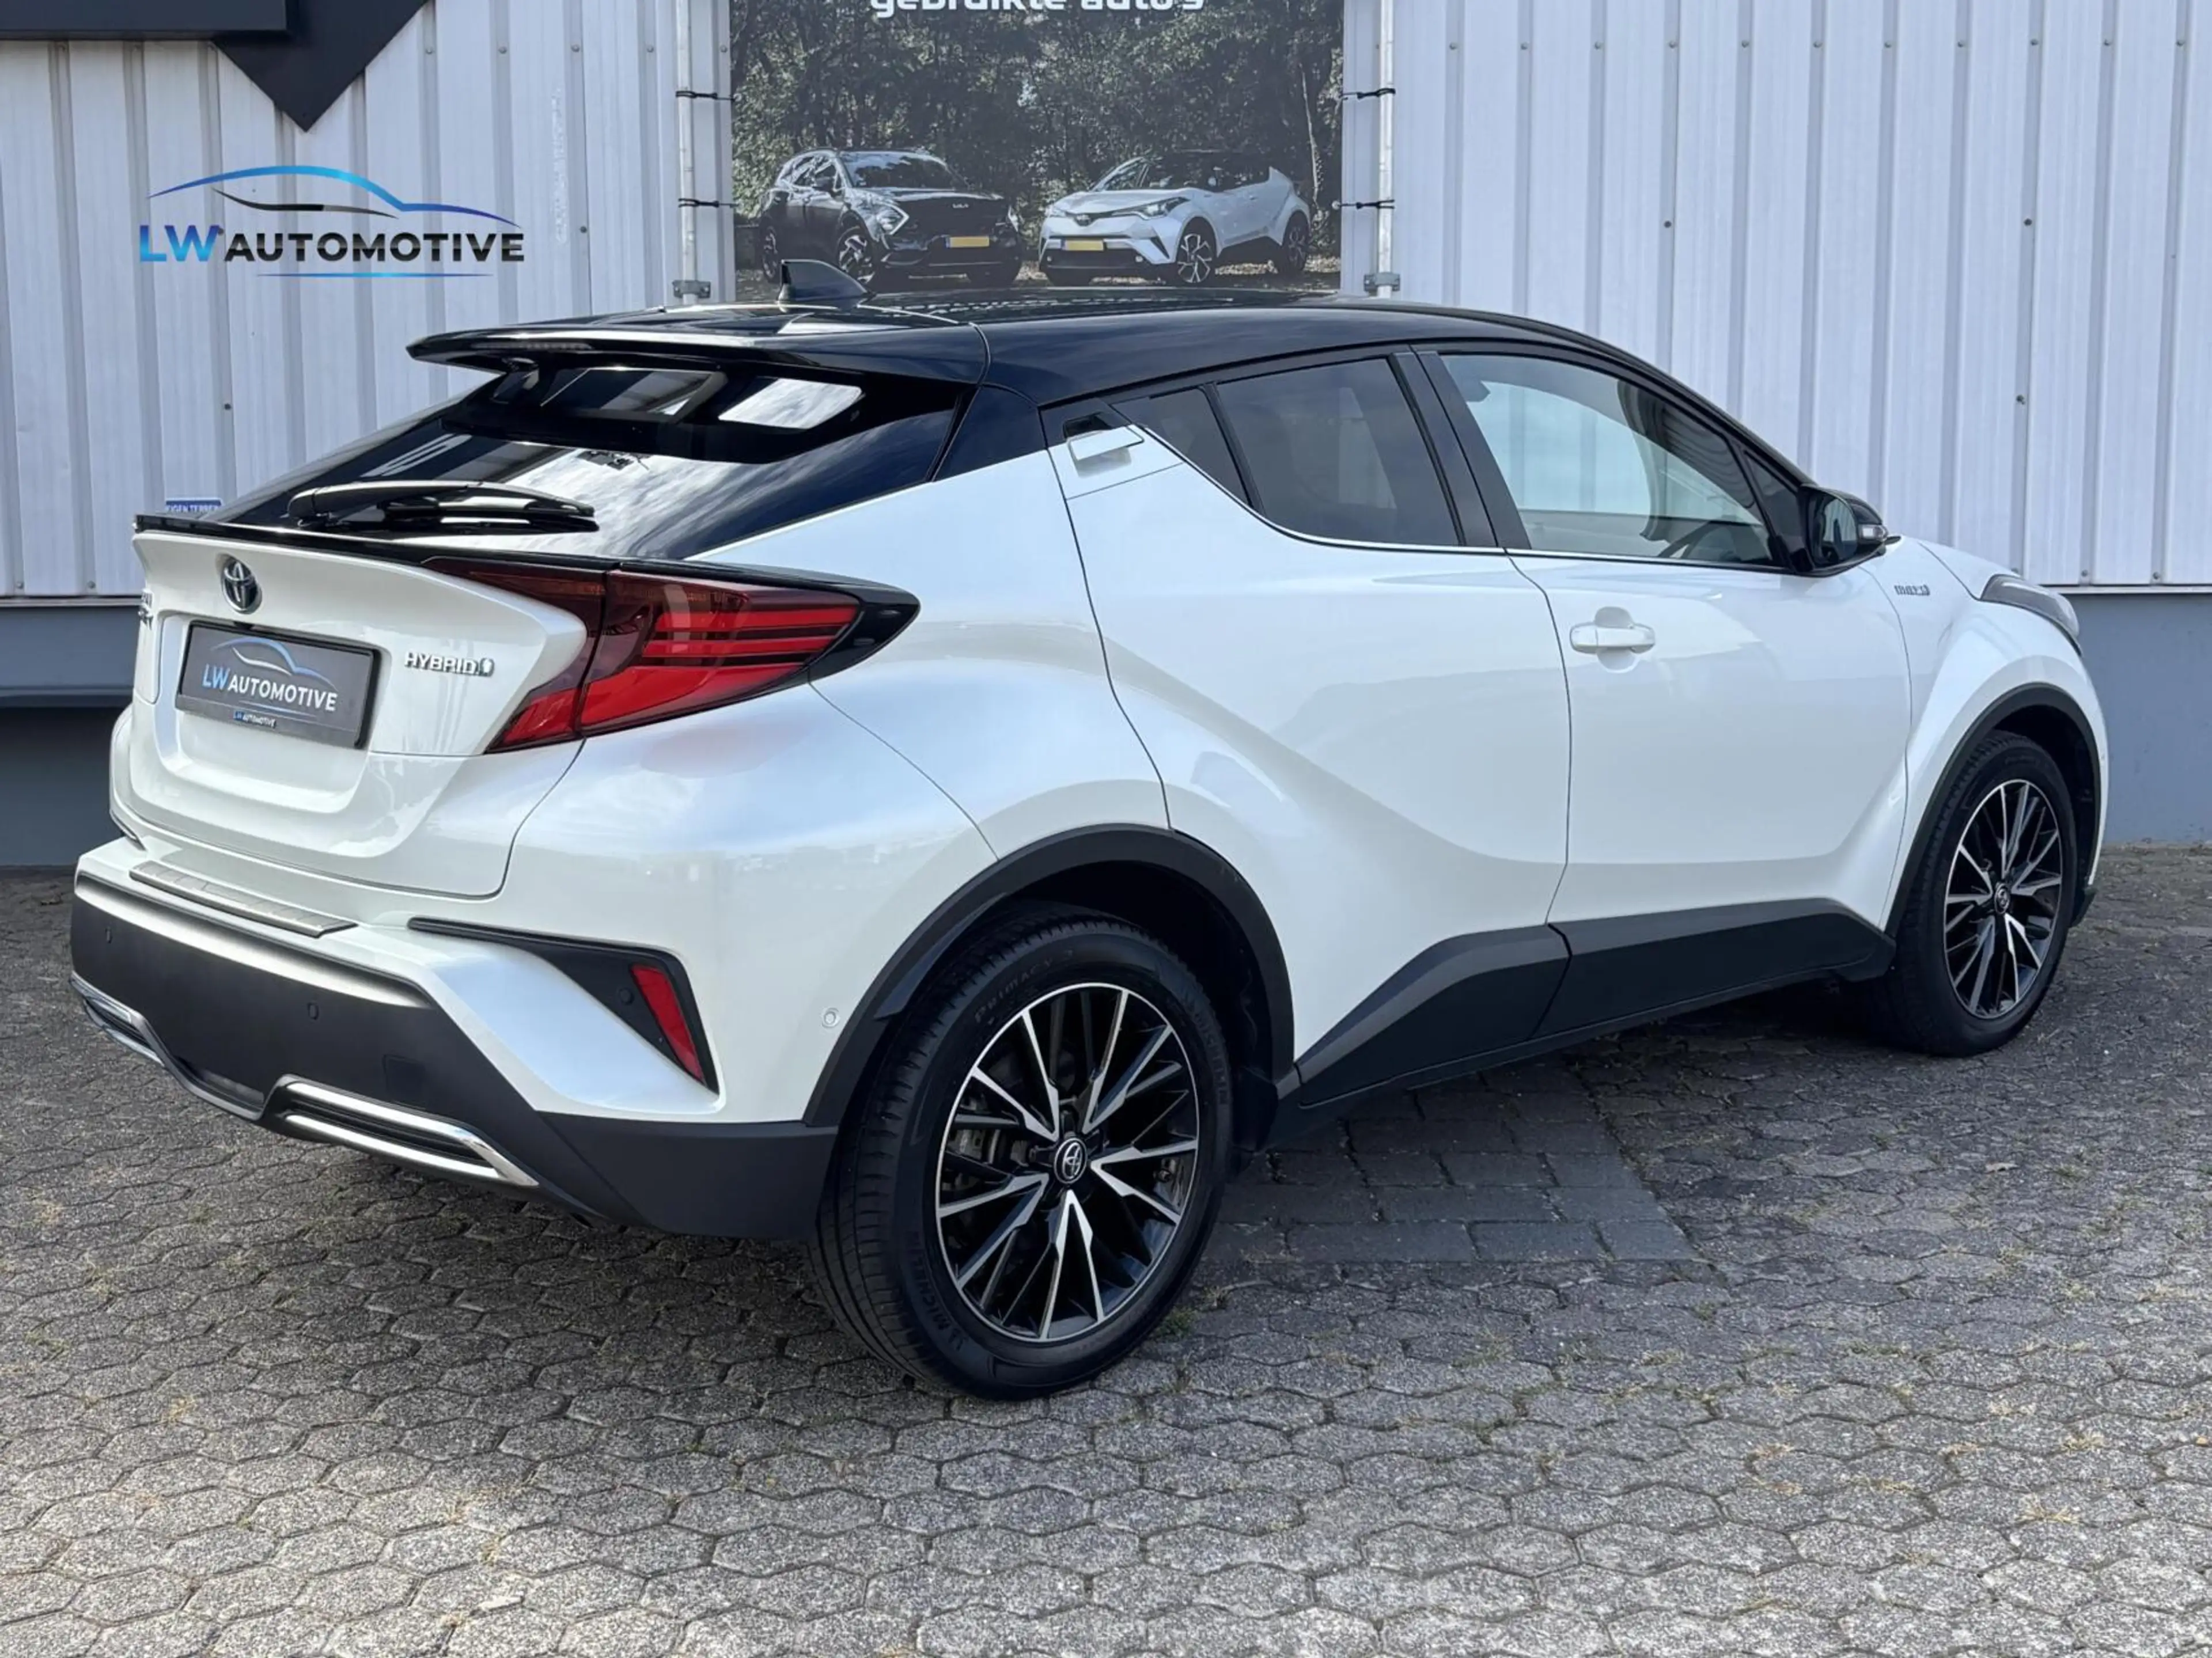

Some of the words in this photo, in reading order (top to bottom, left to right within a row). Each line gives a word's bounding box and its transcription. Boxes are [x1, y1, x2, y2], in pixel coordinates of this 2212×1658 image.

[404, 652, 478, 676] HYBRID
[202, 664, 230, 690] LW
[228, 674, 338, 711] AUTOMOTIVE
